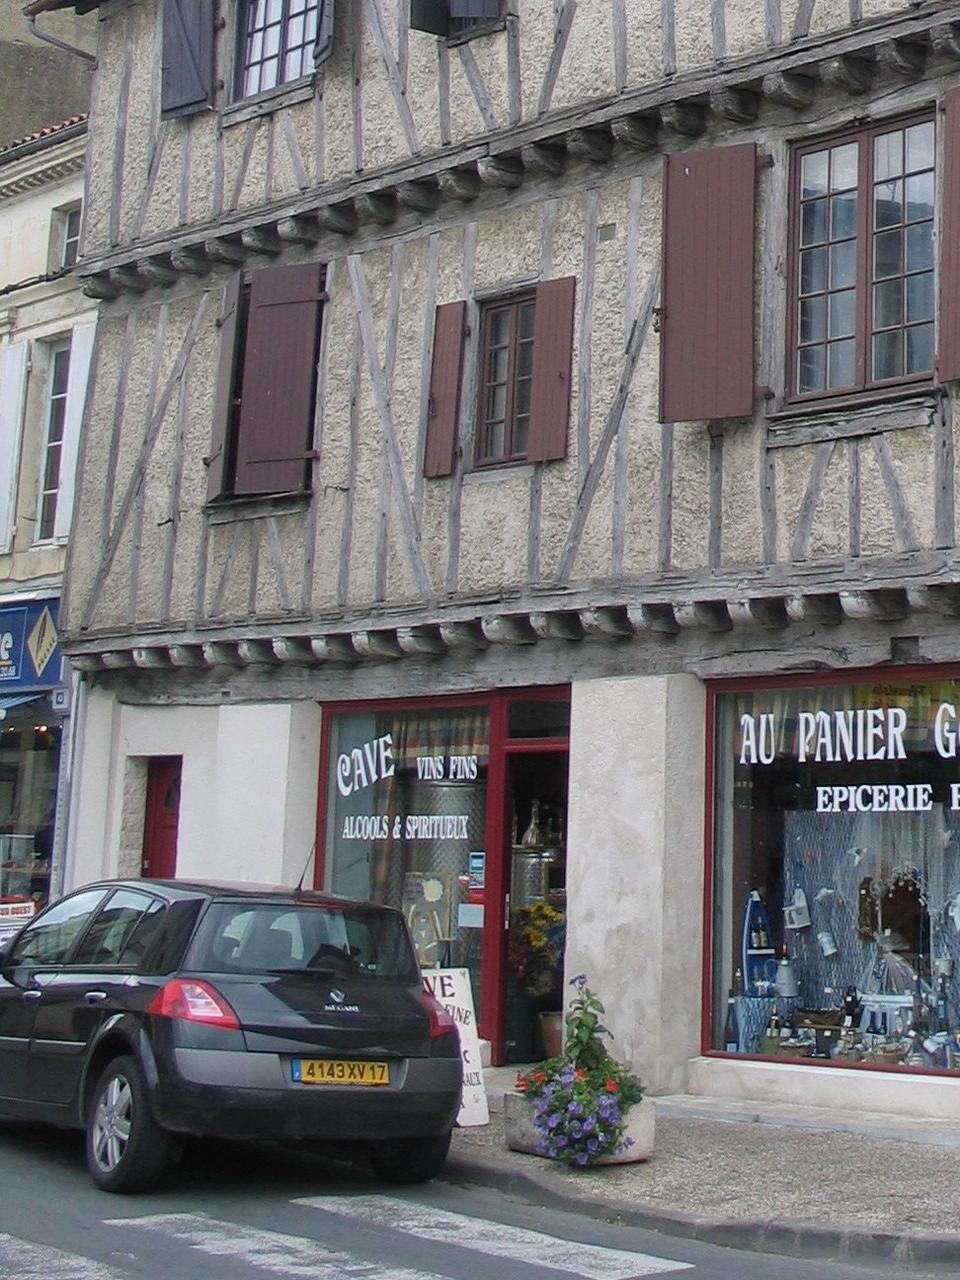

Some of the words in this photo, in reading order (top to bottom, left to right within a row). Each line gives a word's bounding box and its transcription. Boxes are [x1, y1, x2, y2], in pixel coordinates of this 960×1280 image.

[739, 713, 775, 765] AU
[797, 707, 908, 764] PANIER
[336, 733, 395, 796] CAVE
[416, 755, 444, 780] VINS
[449, 755, 478, 780] FINS
[816, 783, 933, 812] EPICERIE
[342, 815, 389, 839] ALCOOLS
[392, 815, 402, 839] &
[405, 815, 469, 839] SPIRITUEUX
[422, 975, 455, 998] VE
[307, 1062, 345, 1079] 4143
[348, 1063, 366, 1080] XV
[369, 1064, 386, 1081] 17
